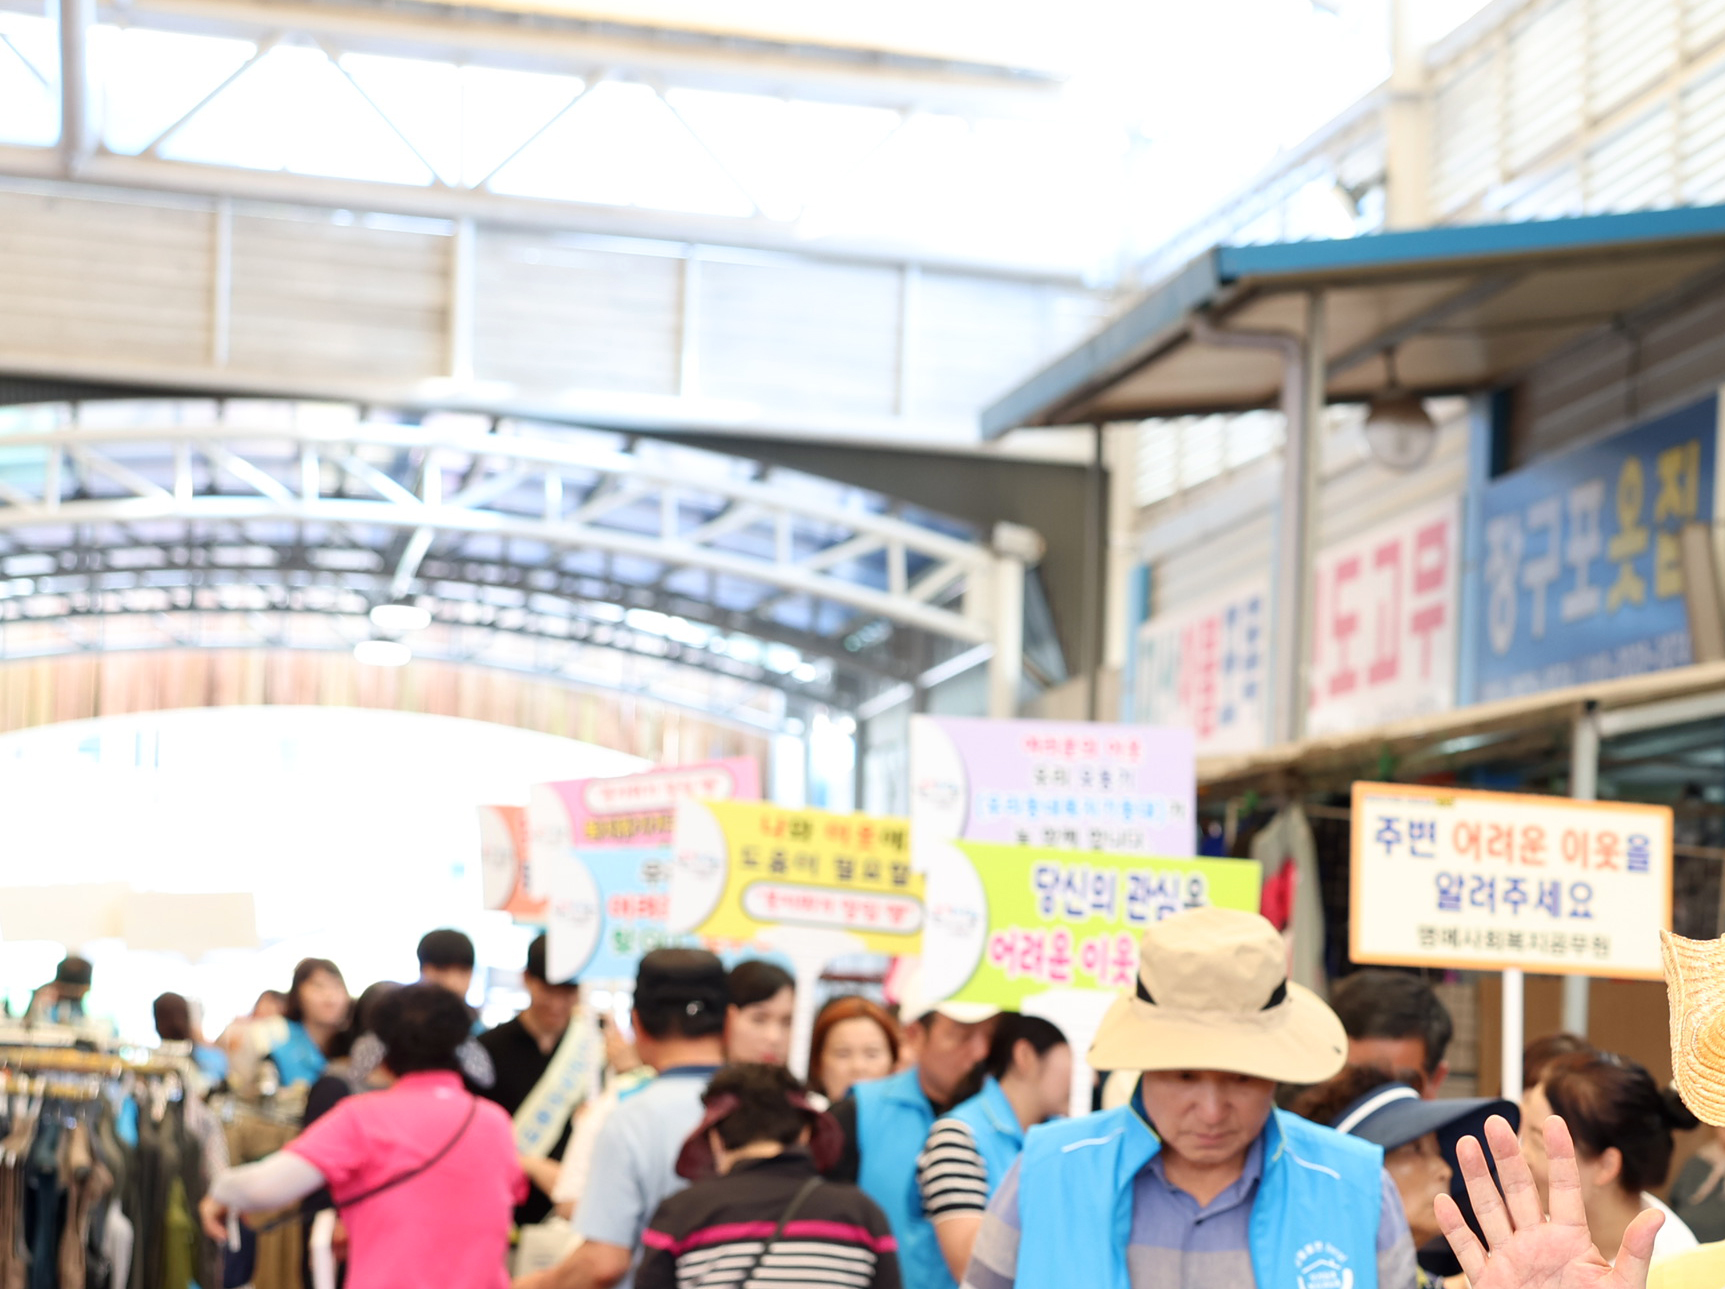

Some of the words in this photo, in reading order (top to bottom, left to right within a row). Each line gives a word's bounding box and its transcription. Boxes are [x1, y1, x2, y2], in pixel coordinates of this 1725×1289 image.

[1309, 520, 1448, 712] 도고무
[743, 846, 818, 875] 도움이
[1375, 815, 1437, 858] 주변
[1452, 821, 1547, 867] 어려운
[1561, 828, 1651, 874] 이웃을
[1037, 866, 1117, 916] 당신의
[1435, 870, 1594, 919] 알려주세요
[992, 932, 1071, 981] 어려운
